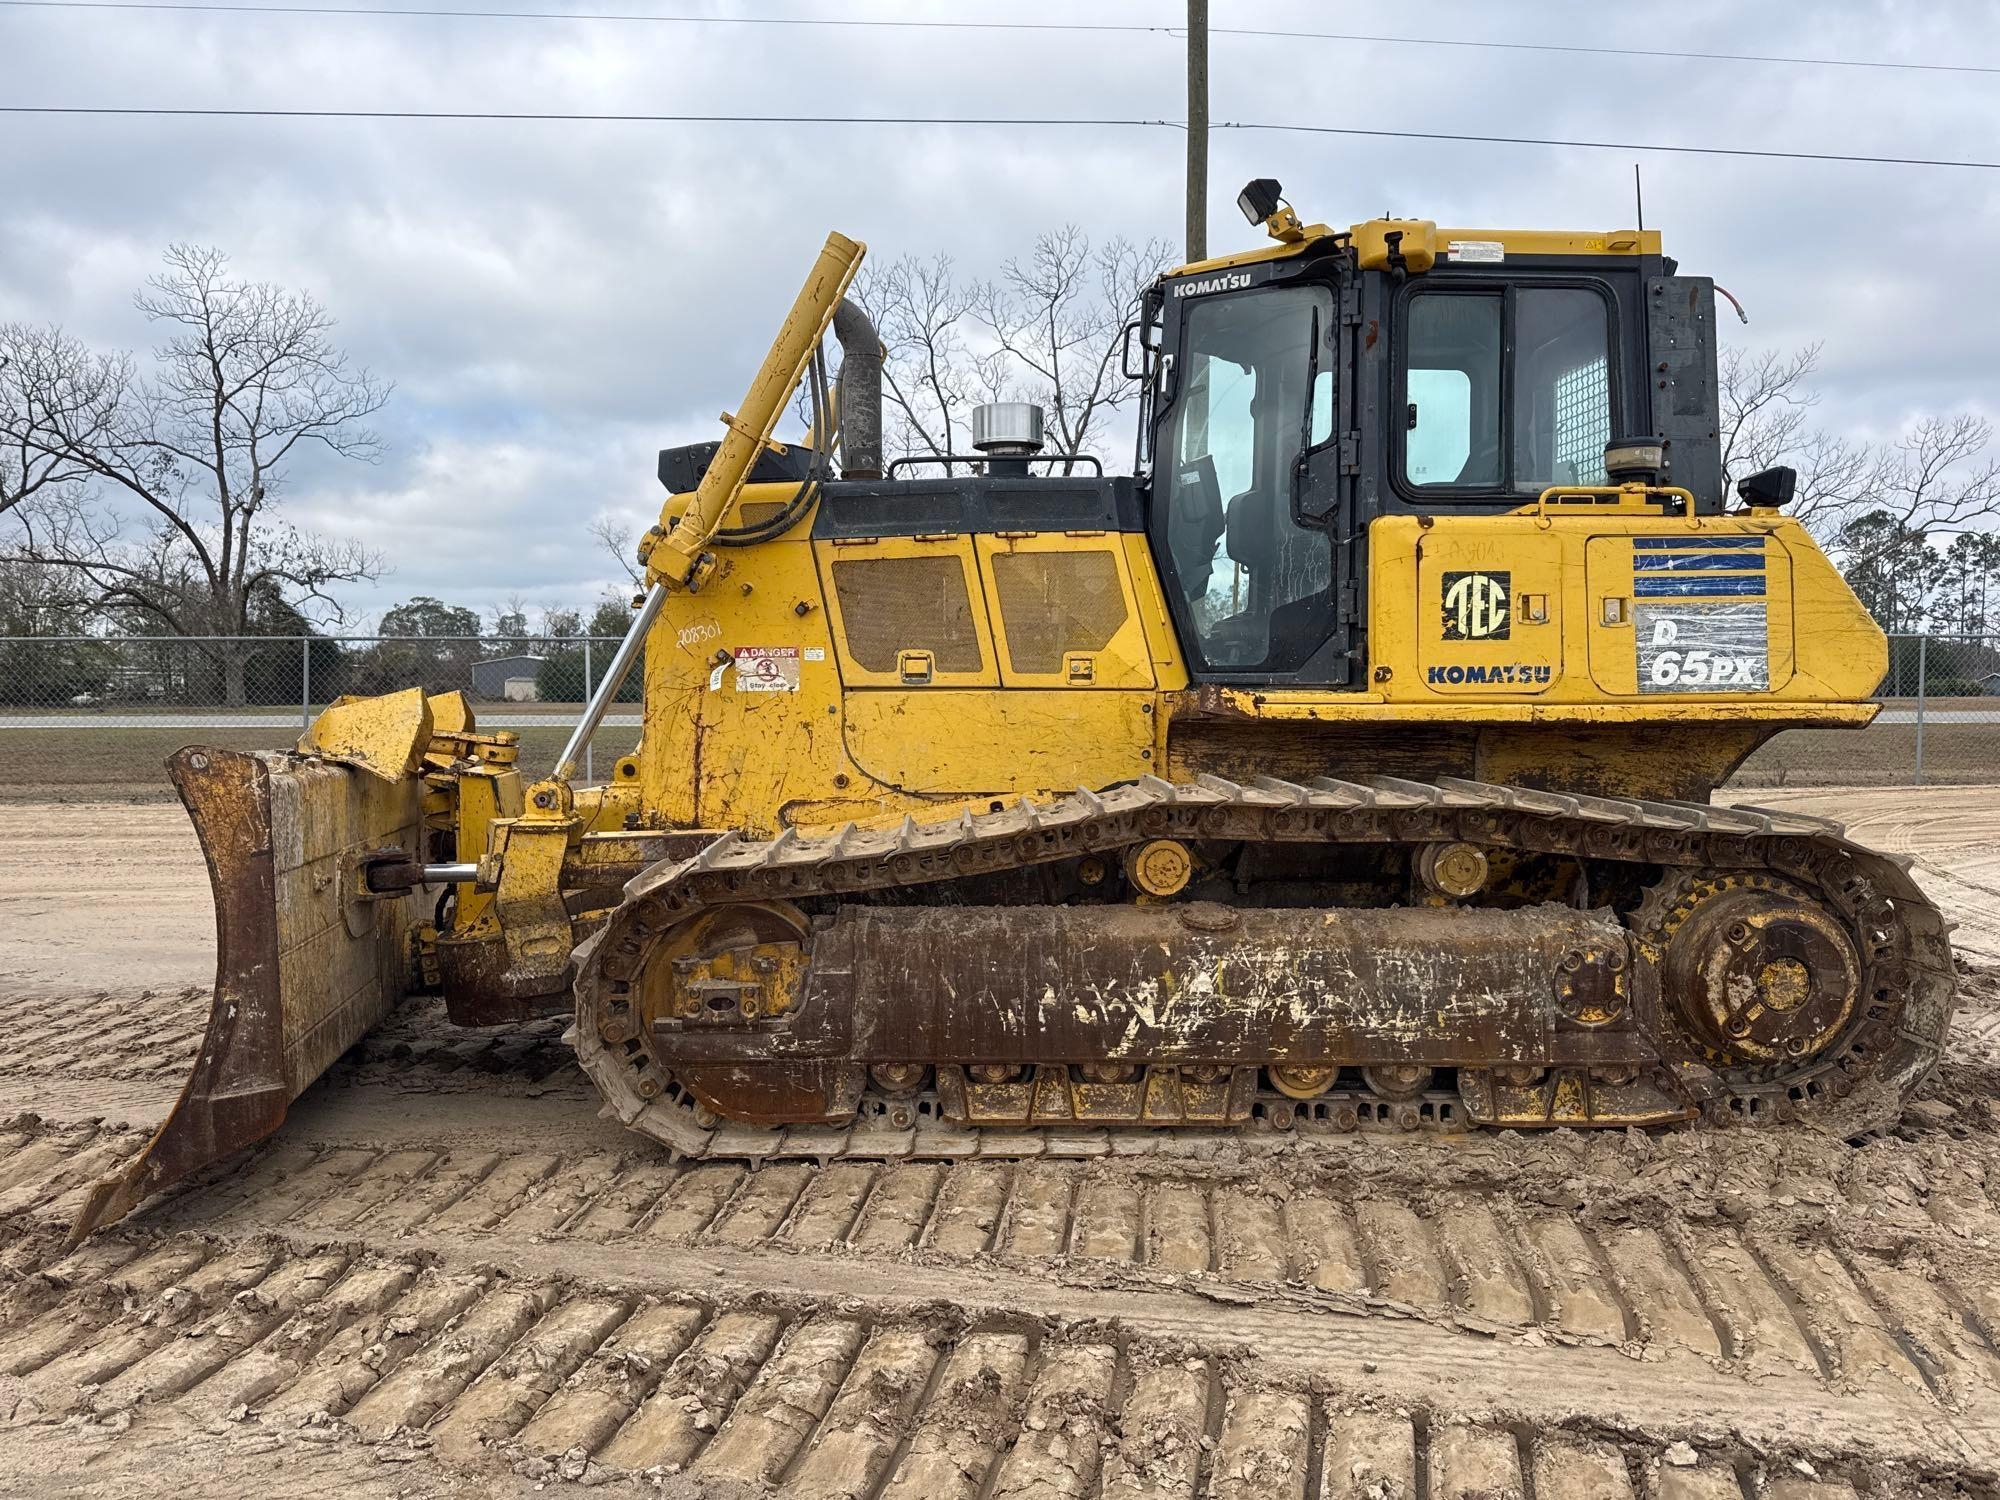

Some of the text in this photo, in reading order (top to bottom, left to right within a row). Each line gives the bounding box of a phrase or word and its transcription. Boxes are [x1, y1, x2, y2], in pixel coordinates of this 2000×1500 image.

[1173, 273, 1251, 298] KOMATSU
[1445, 575, 1506, 637] TEC
[676, 620, 720, 648] 208301
[1652, 620, 1678, 646] D
[750, 648, 795, 657] DANGER
[1428, 664, 1551, 684] KOMATSU
[1651, 651, 1757, 686] 65PX
[749, 682, 765, 690] Stay
